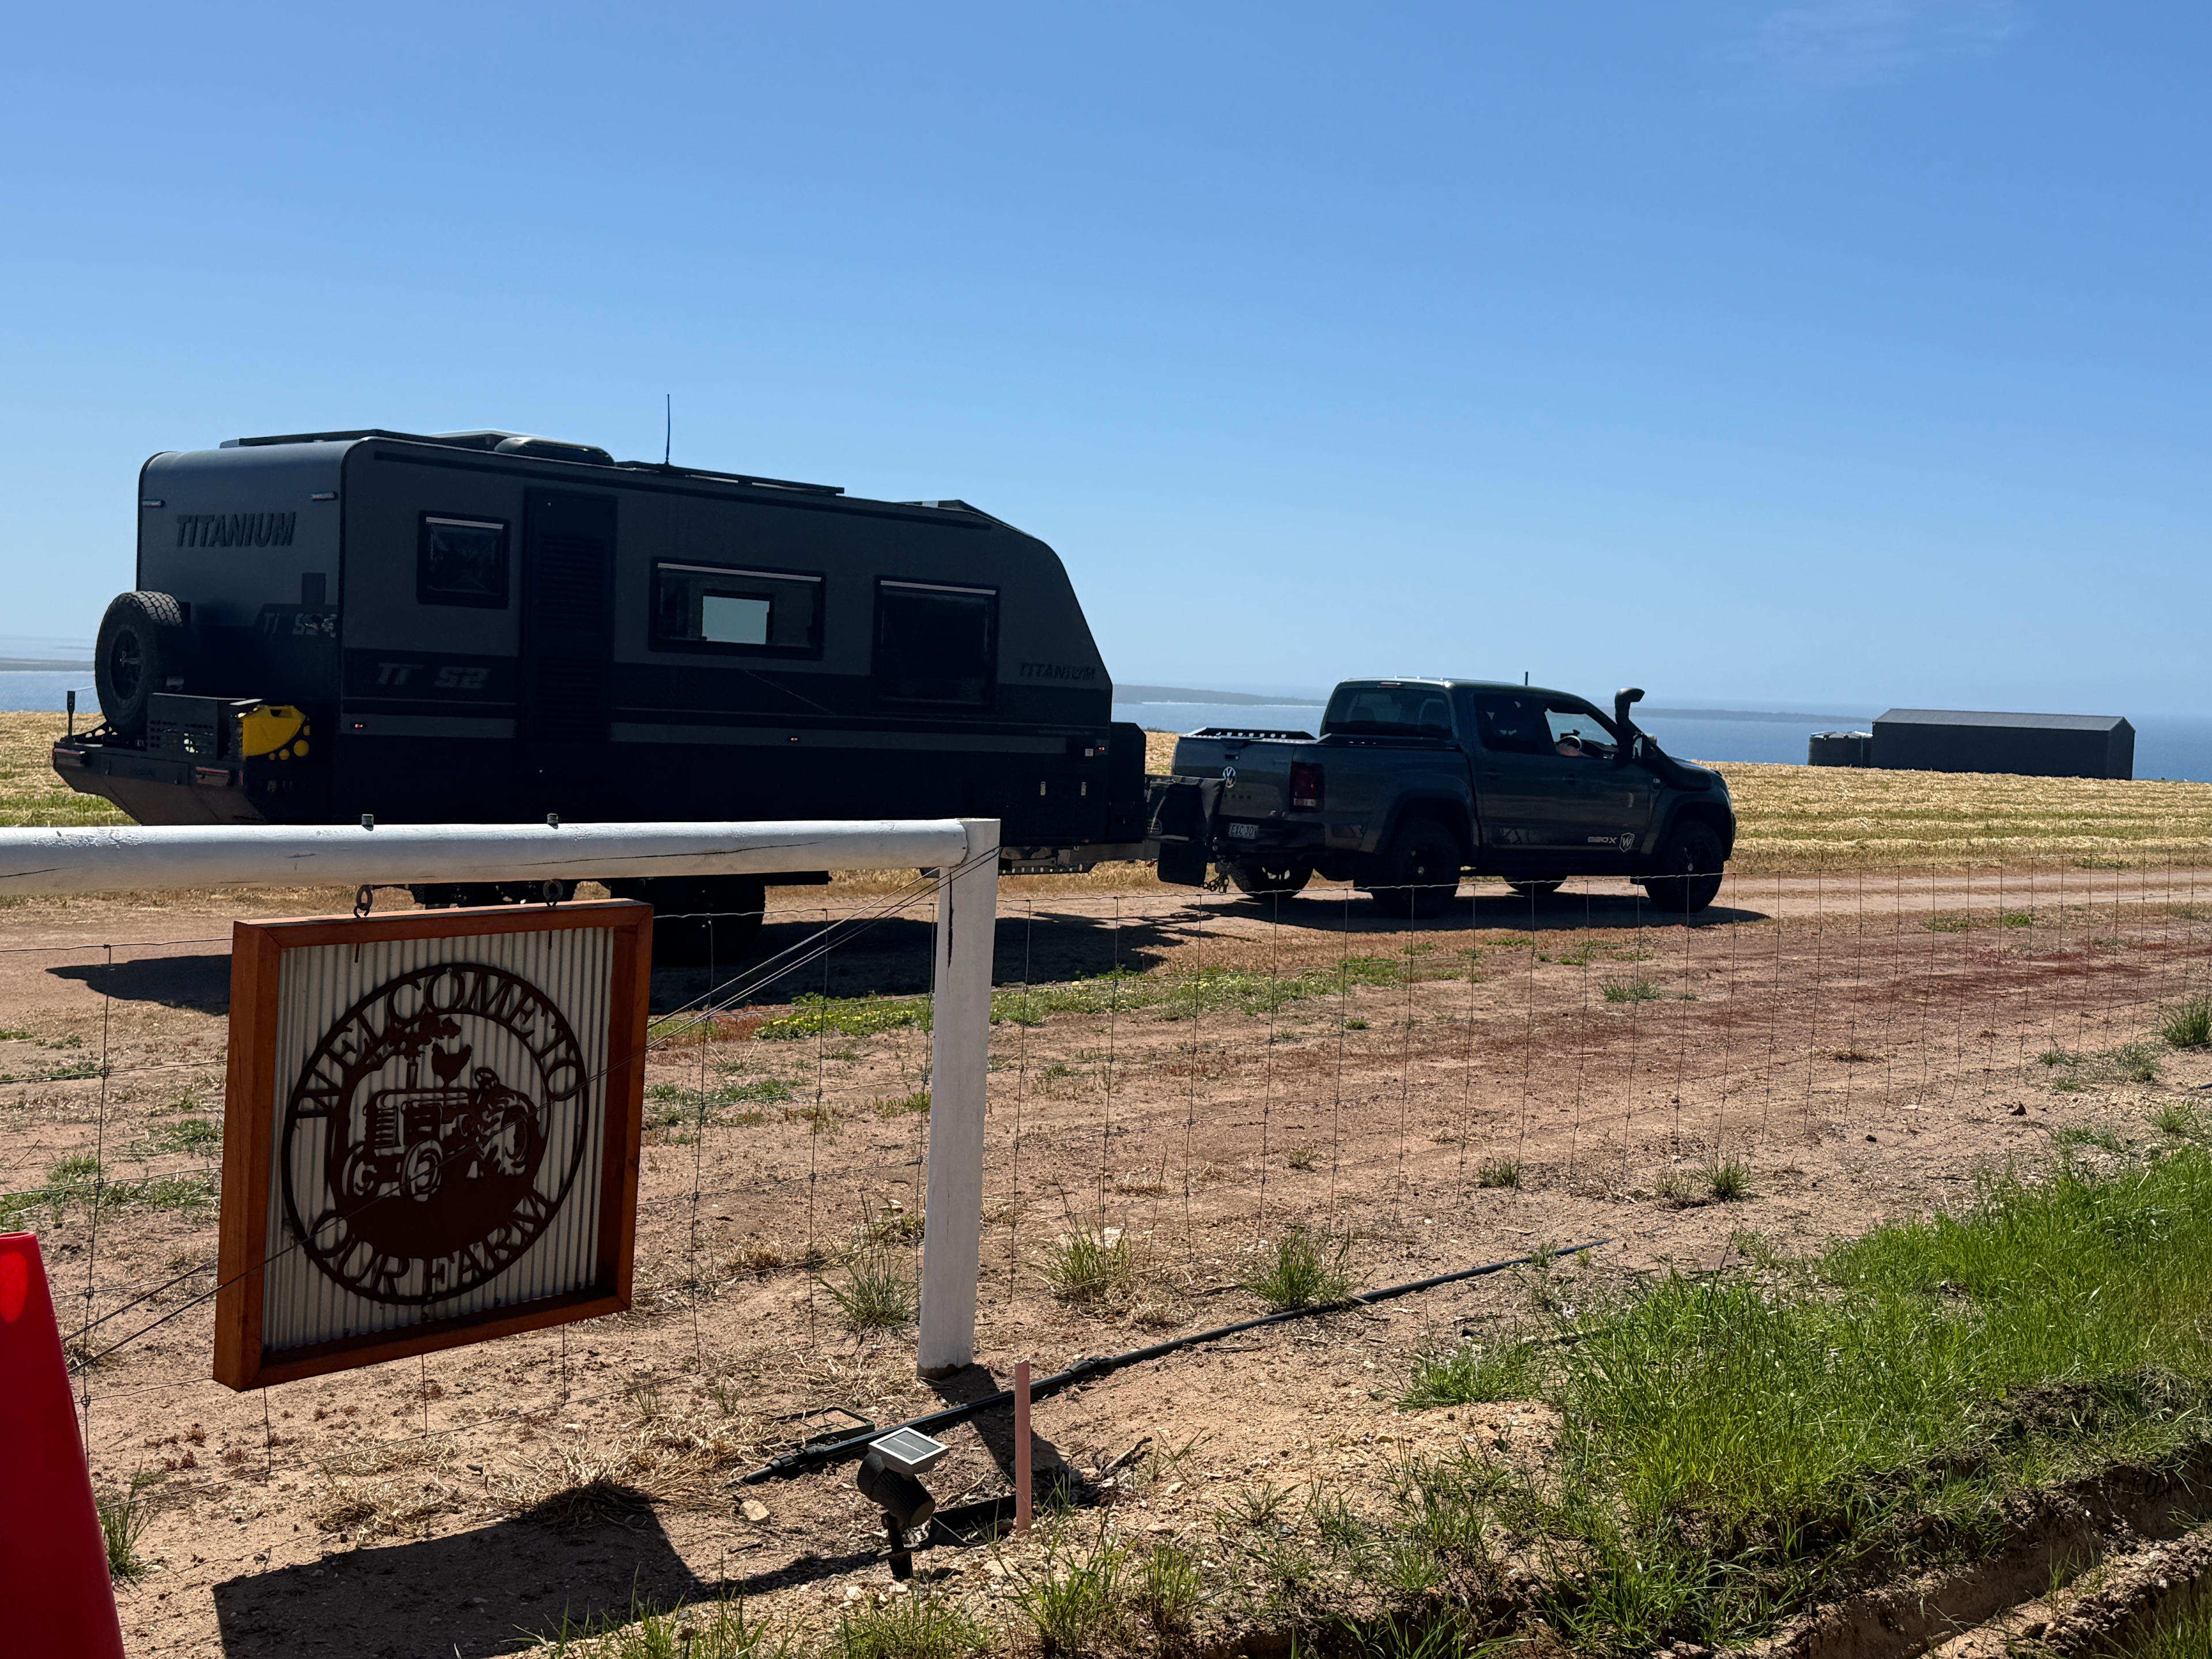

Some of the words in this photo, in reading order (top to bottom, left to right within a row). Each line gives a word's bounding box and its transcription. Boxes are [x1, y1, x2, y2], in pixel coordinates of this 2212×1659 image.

[176, 512, 296, 548] TITANIUM
[1018, 662, 1097, 681] TITANIUM
[293, 970, 547, 1120] WELCOME
[537, 1025, 577, 1101] TO
[310, 1211, 411, 1296] OUR
[424, 1189, 559, 1296] FARM
